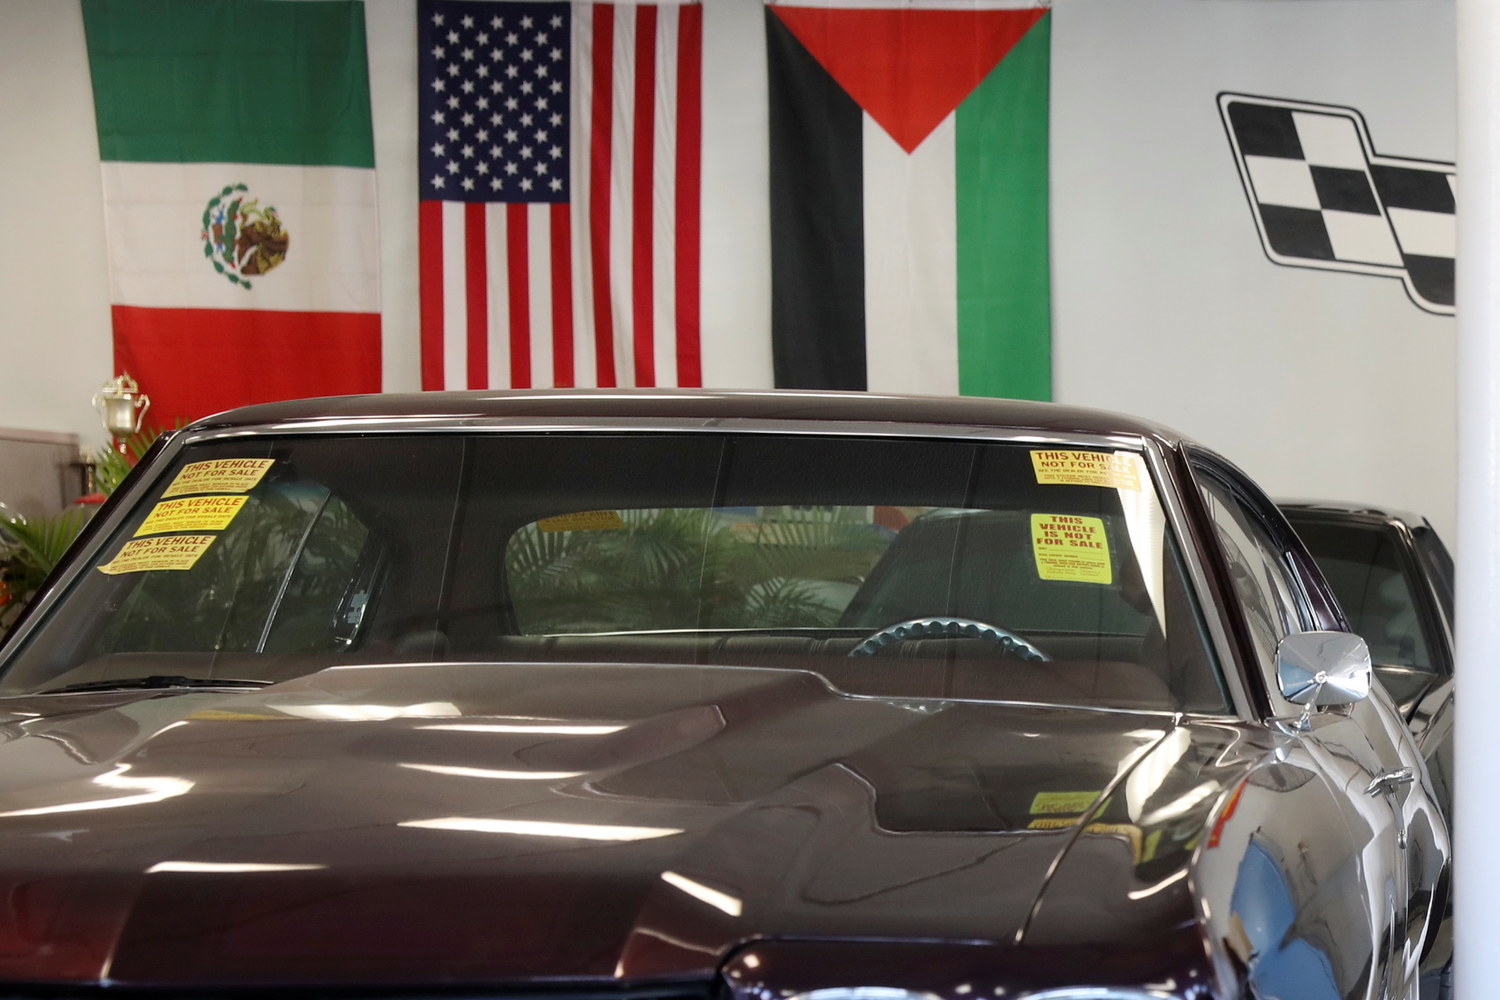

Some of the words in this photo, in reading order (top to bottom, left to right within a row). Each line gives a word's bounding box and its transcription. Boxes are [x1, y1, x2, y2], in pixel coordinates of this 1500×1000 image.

[1036, 452, 1069, 461] THIS
[185, 462, 211, 473] THIS
[214, 460, 269, 469] VEHICLE
[180, 472, 202, 480] NOT
[158, 502, 184, 511] THIS
[187, 498, 242, 507] VEHICLE
[154, 510, 174, 518] NOT
[1050, 516, 1083, 524] THIS
[1039, 523, 1097, 533] VEHICLE
[1064, 532, 1093, 540] NOT
[127, 540, 152, 550] THIS
[155, 536, 211, 545] VEHICLE
[1069, 540, 1103, 549] SALE
[120, 550, 142, 558] NOT
